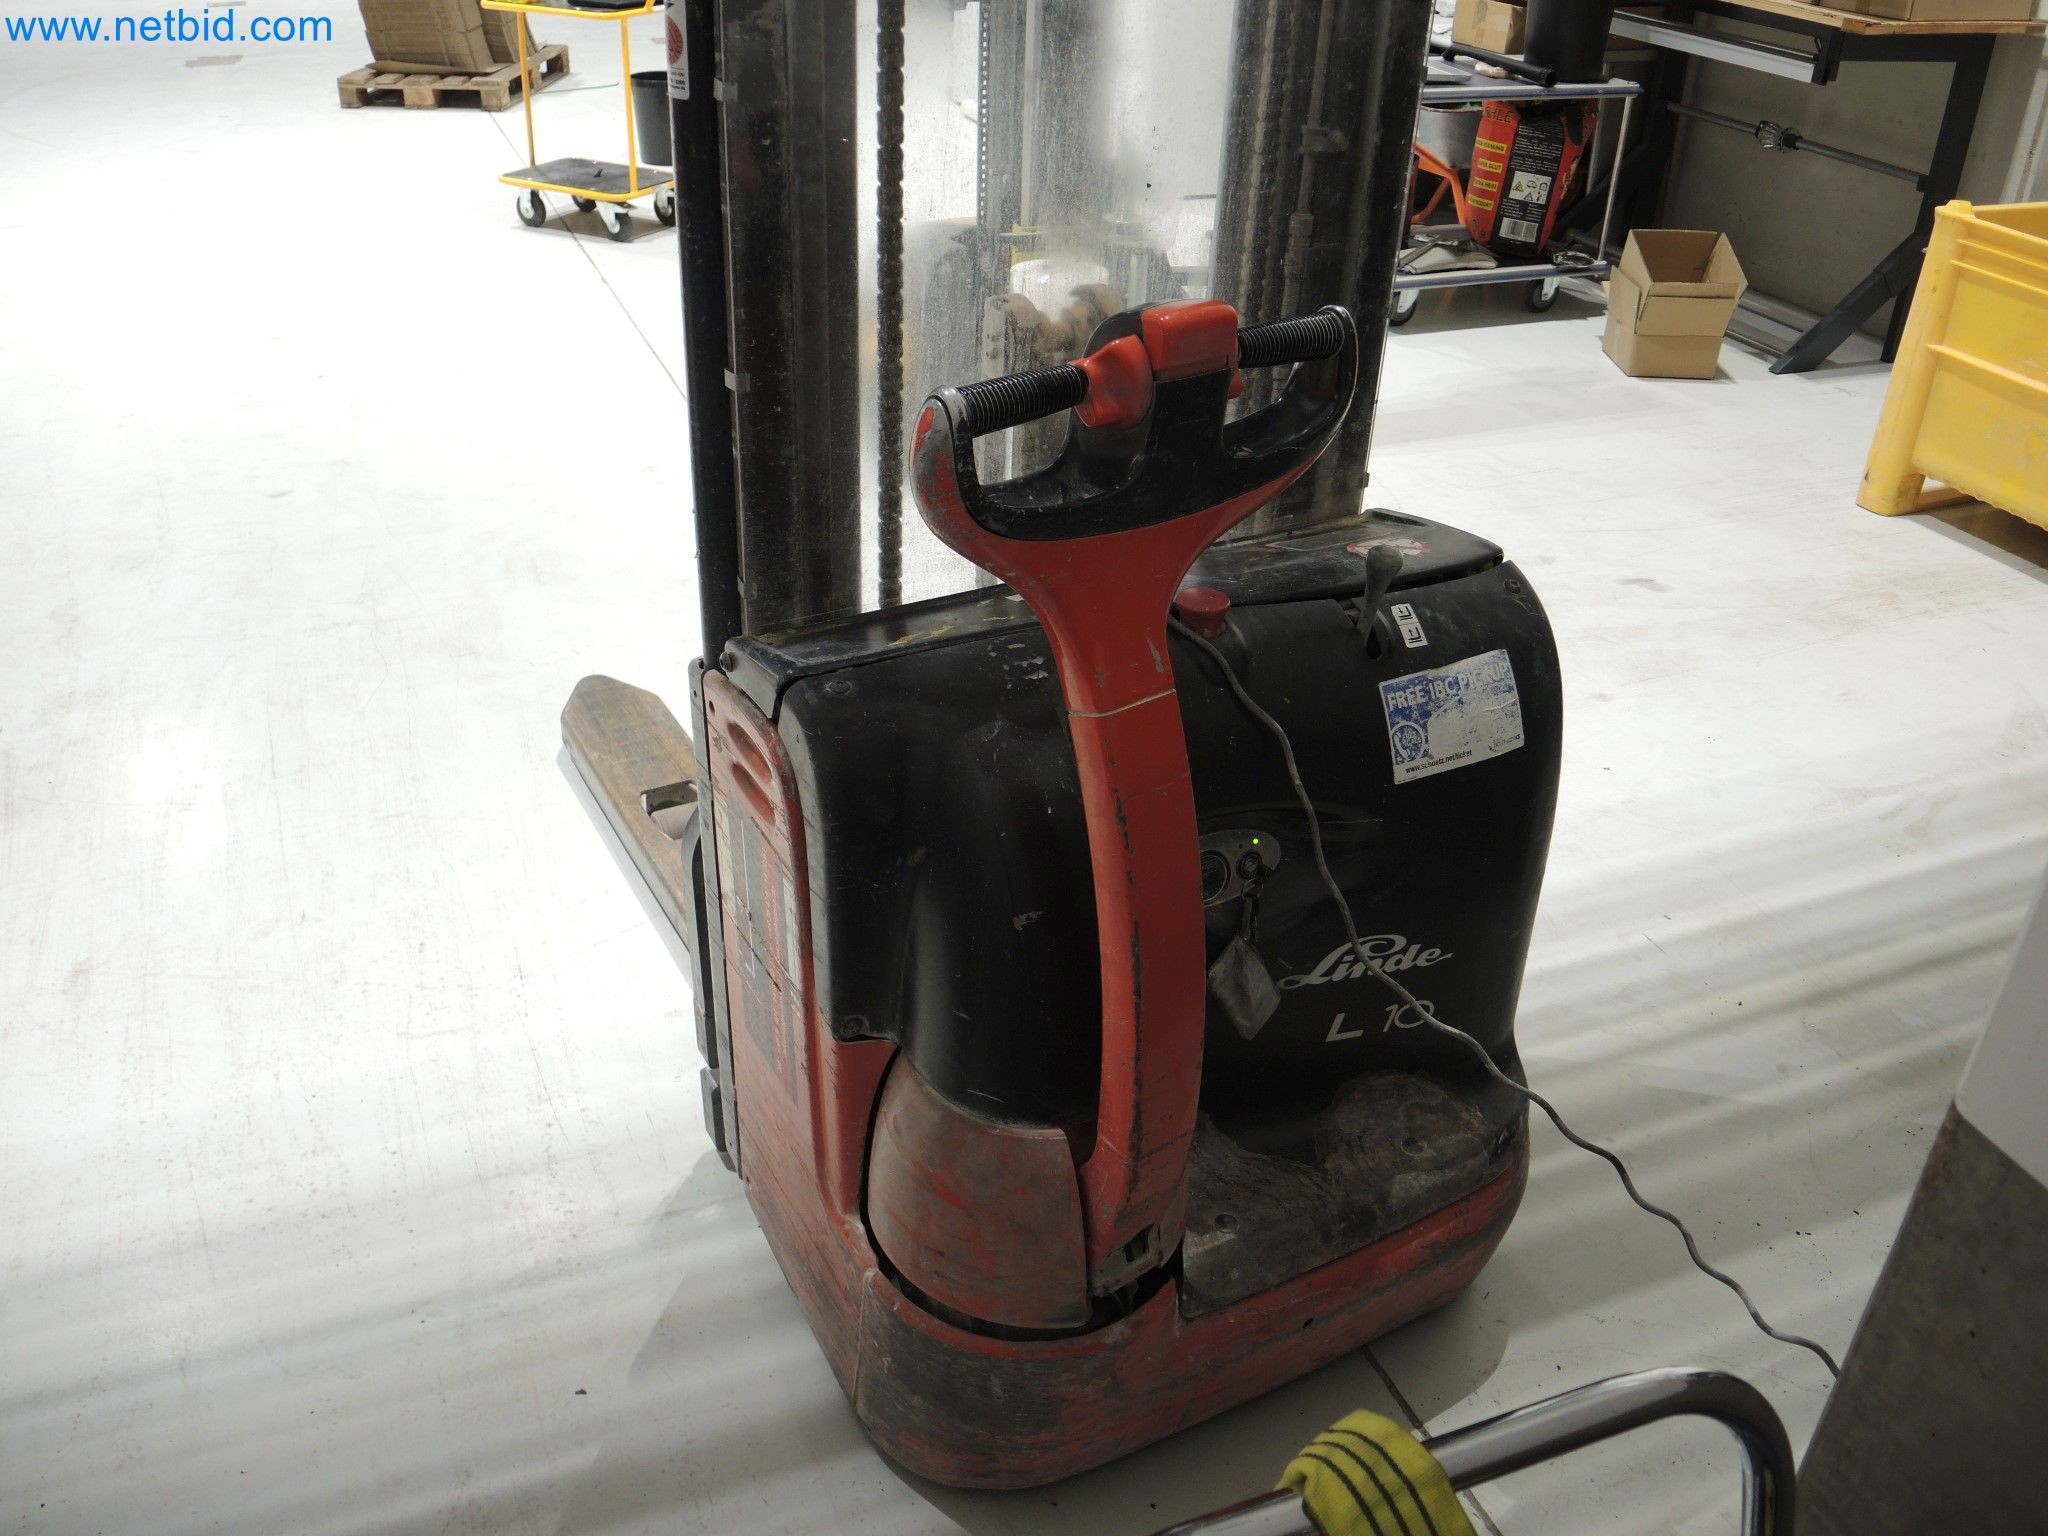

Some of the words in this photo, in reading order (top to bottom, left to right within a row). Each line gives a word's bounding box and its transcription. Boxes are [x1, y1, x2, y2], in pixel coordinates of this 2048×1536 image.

[1386, 685, 1424, 711] FREE
[1428, 677, 1457, 699] IBC
[1276, 934, 1453, 990] Linde
[1325, 1012, 1364, 1042] L
[1382, 999, 1435, 1033] 10
